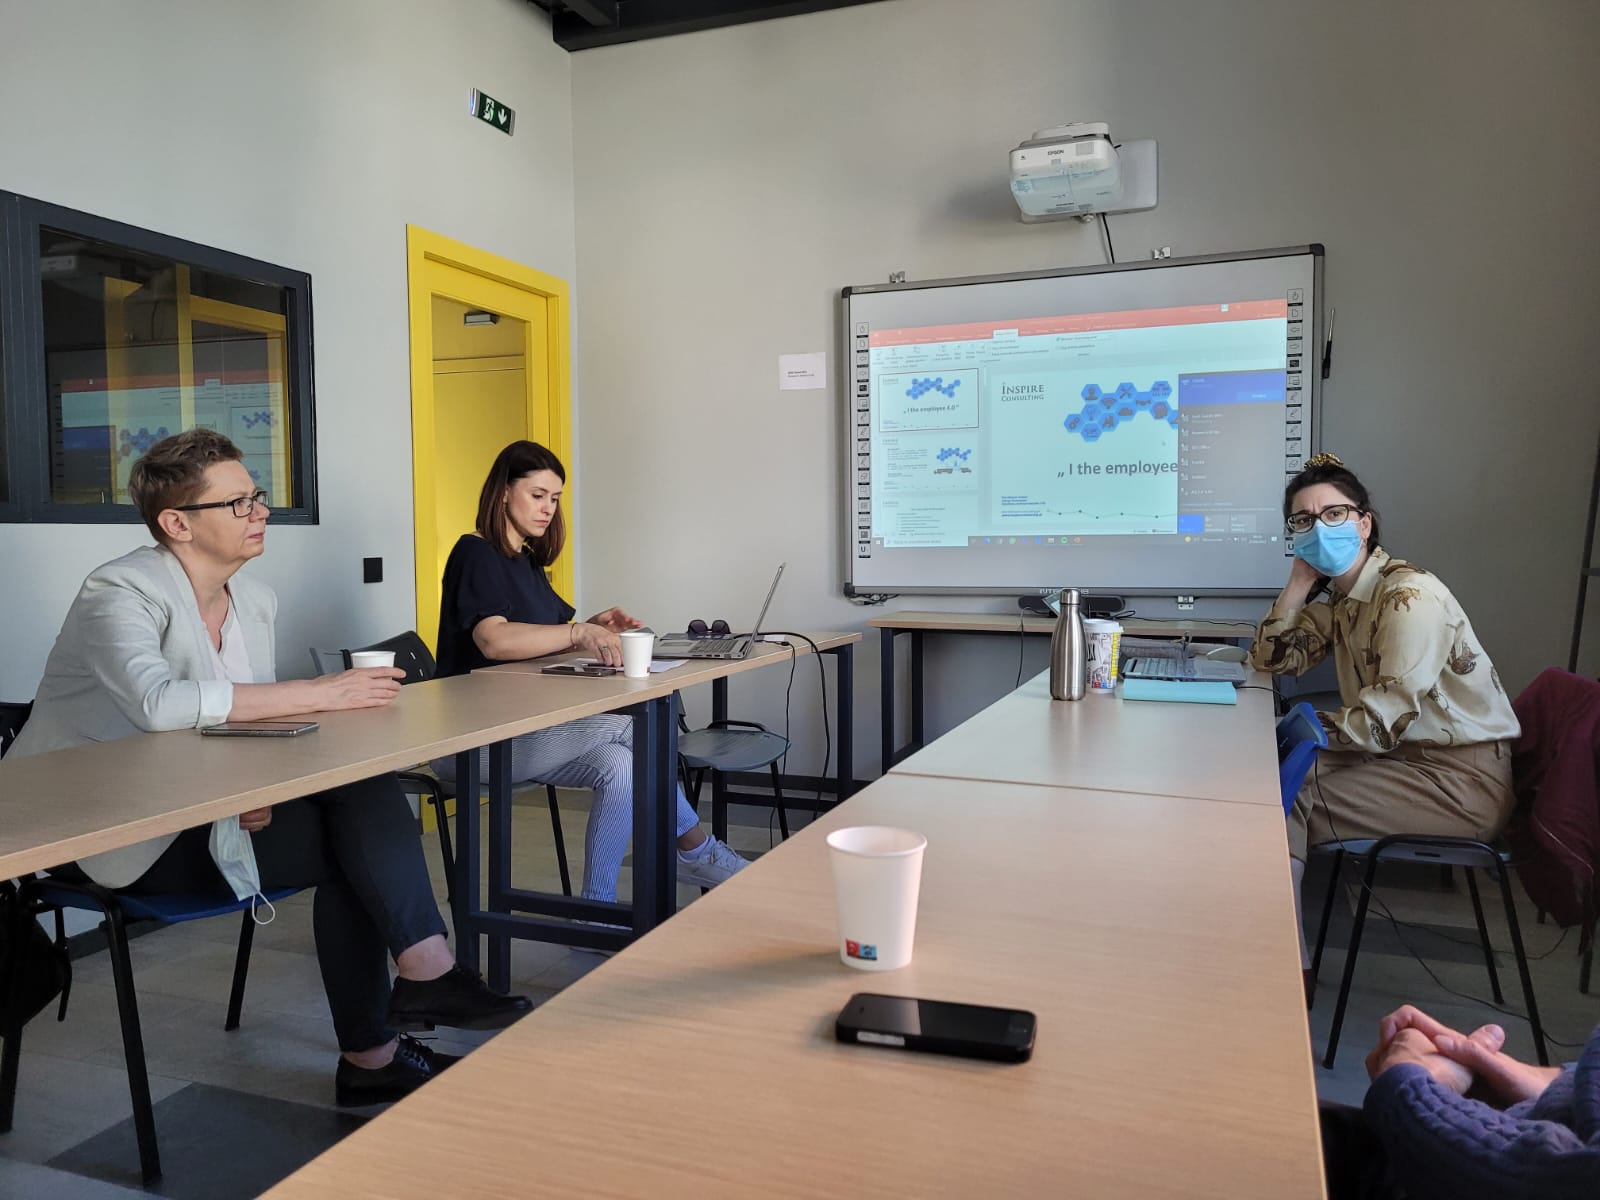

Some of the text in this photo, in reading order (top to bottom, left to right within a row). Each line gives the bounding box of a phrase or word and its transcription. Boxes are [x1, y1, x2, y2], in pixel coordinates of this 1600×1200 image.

[1002, 384, 1045, 395] INSPIRE
[1001, 394, 1045, 402] CONSULTING
[1069, 463, 1073, 475] I
[1077, 462, 1101, 475] the
[1105, 460, 1178, 476] employee
